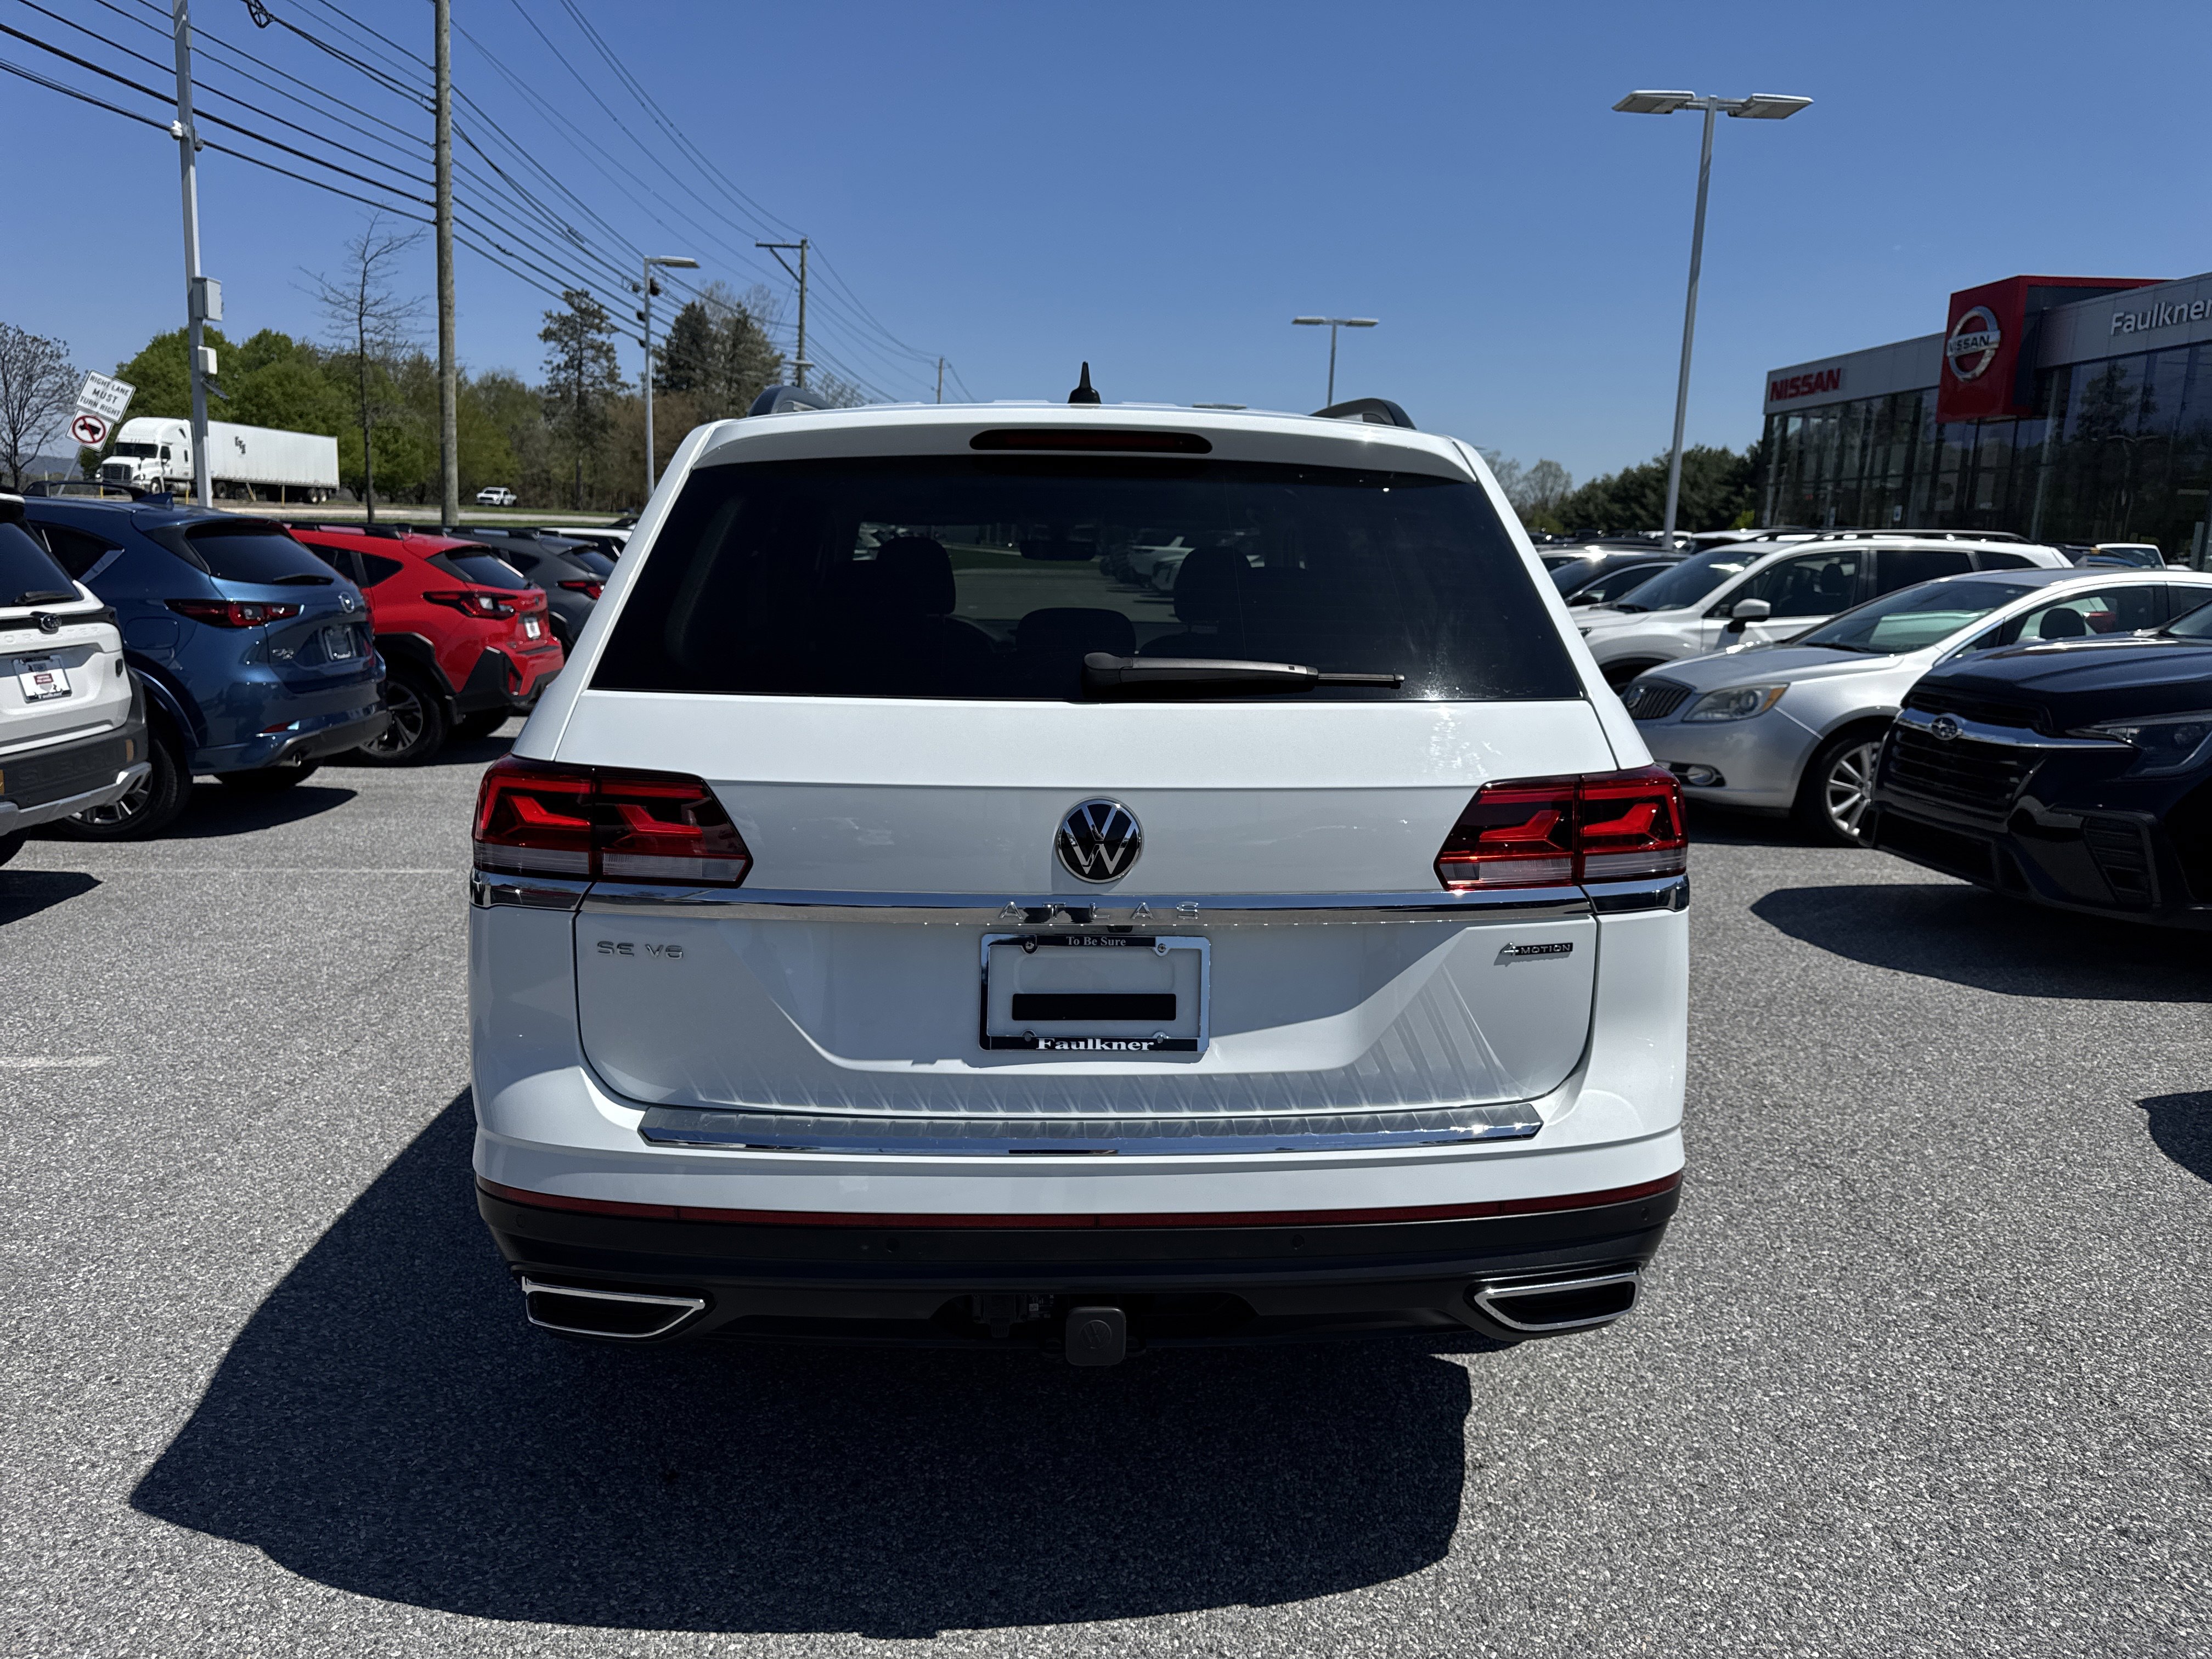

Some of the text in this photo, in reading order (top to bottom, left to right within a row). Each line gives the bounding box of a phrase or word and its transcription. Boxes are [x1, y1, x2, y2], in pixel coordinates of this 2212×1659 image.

[2111, 298, 2212, 336] Faulkner
[89, 375, 129, 397] RIGHT LANE
[1770, 368, 1842, 401] NISSAN
[80, 395, 121, 417] TURN RIGHT
[92, 388, 119, 404] MUST
[998, 901, 1199, 920] ATLAS
[597, 940, 684, 960] SE V6
[1065, 936, 1126, 946] To Be Sure
[1036, 1037, 1154, 1051] Faulkner
